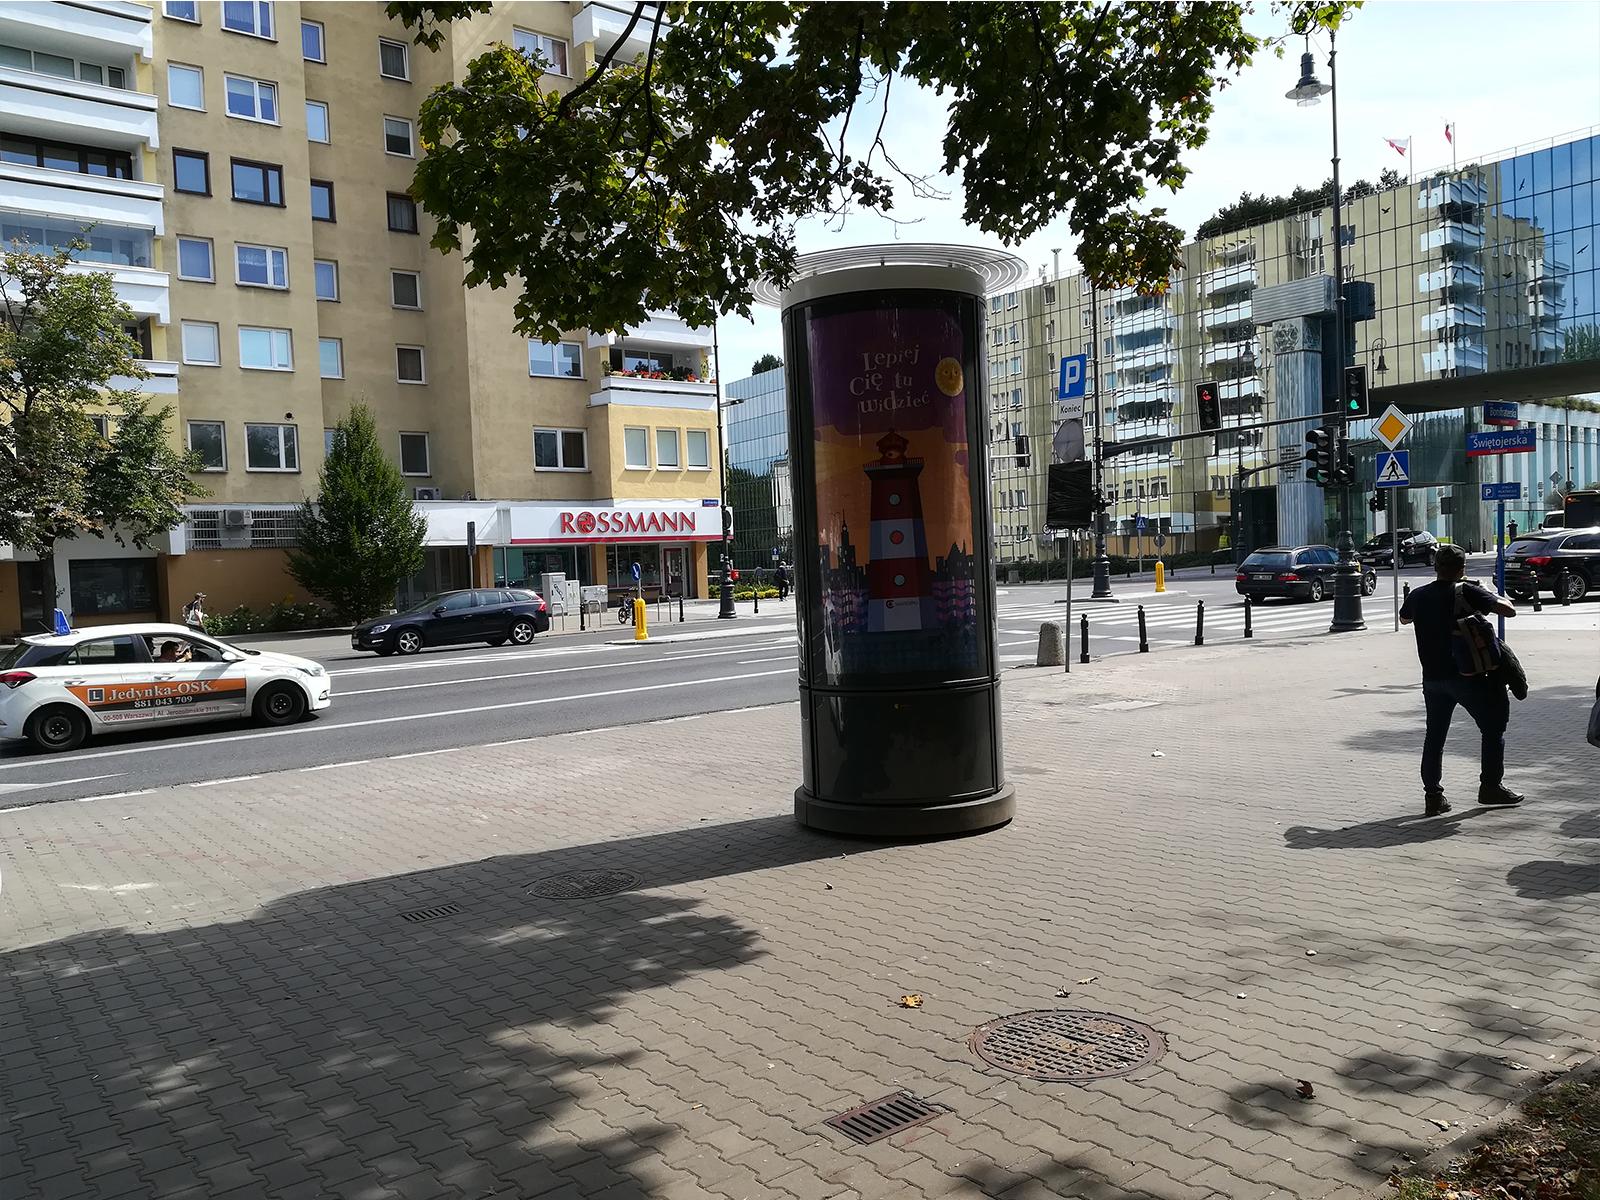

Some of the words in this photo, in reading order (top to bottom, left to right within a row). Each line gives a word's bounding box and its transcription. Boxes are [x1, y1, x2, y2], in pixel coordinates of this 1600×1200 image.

[863, 344, 920, 371] Lepiej
[849, 371, 883, 396] Cię
[895, 373, 913, 389] tu
[1065, 360, 1080, 394] P
[860, 390, 929, 413] widzieć
[1060, 404, 1081, 414] Koniec
[1473, 435, 1528, 449] Świętojerska
[1486, 488, 1491, 496] P
[560, 511, 696, 534] ROSSMANN
[109, 681, 213, 701] Jedynka-OSK
[134, 700, 151, 708] 881
[156, 698, 173, 706] 043
[176, 696, 193, 704] 709
